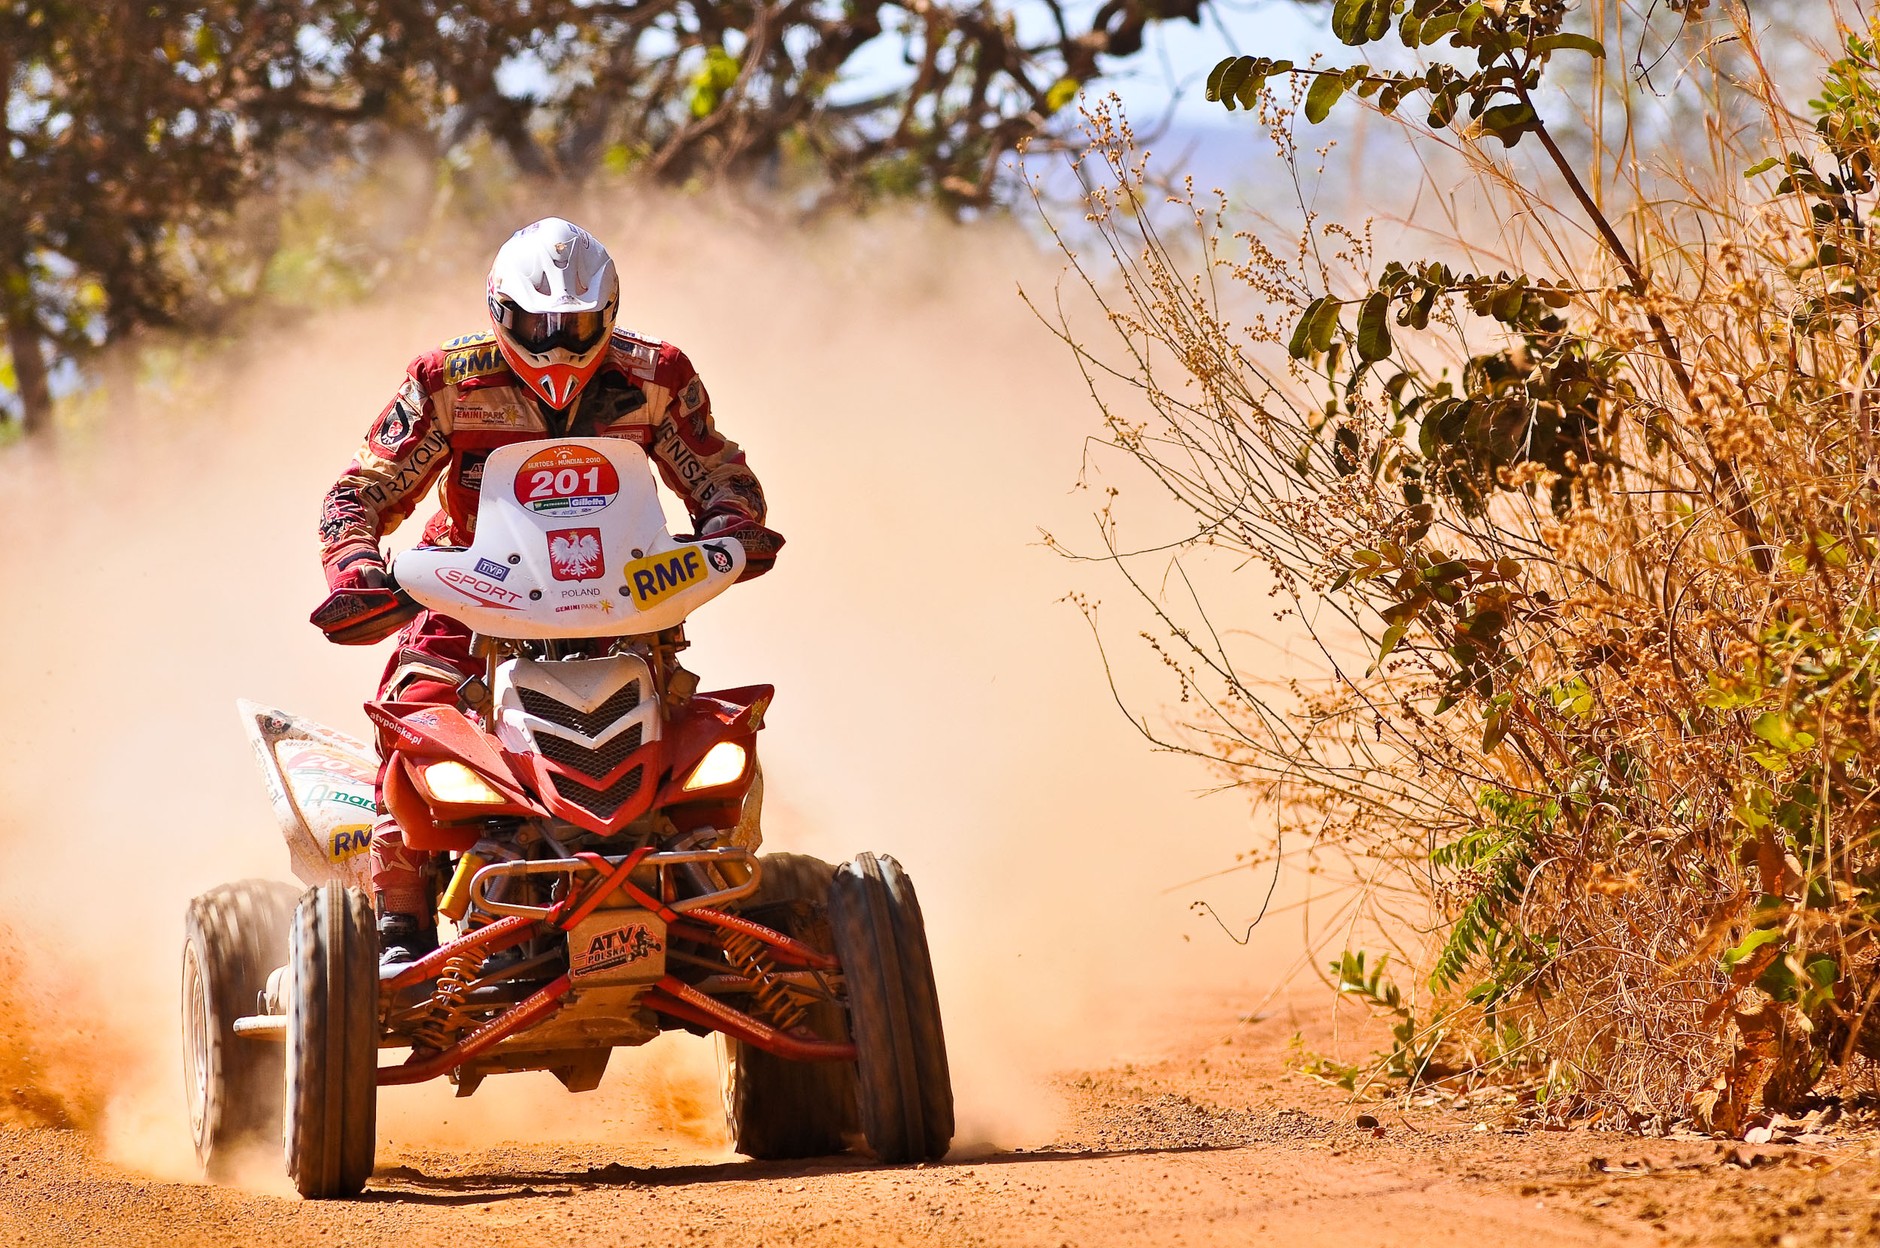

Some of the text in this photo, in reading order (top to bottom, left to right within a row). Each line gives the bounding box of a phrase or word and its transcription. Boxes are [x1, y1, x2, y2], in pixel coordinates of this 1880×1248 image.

[529, 467, 599, 498] 201
[572, 499, 605, 507] Gillette
[480, 562, 504, 578] TVP
[633, 551, 700, 601] RMF
[445, 570, 523, 604] SPORT
[561, 587, 601, 598] POLAND
[555, 603, 599, 613] GEMINI PARK
[370, 712, 423, 746] atvpolska.pl
[334, 829, 373, 856] RM
[589, 926, 634, 955] ATV
[588, 947, 626, 964] POLSKA
[506, 991, 551, 1023] POLSKI
